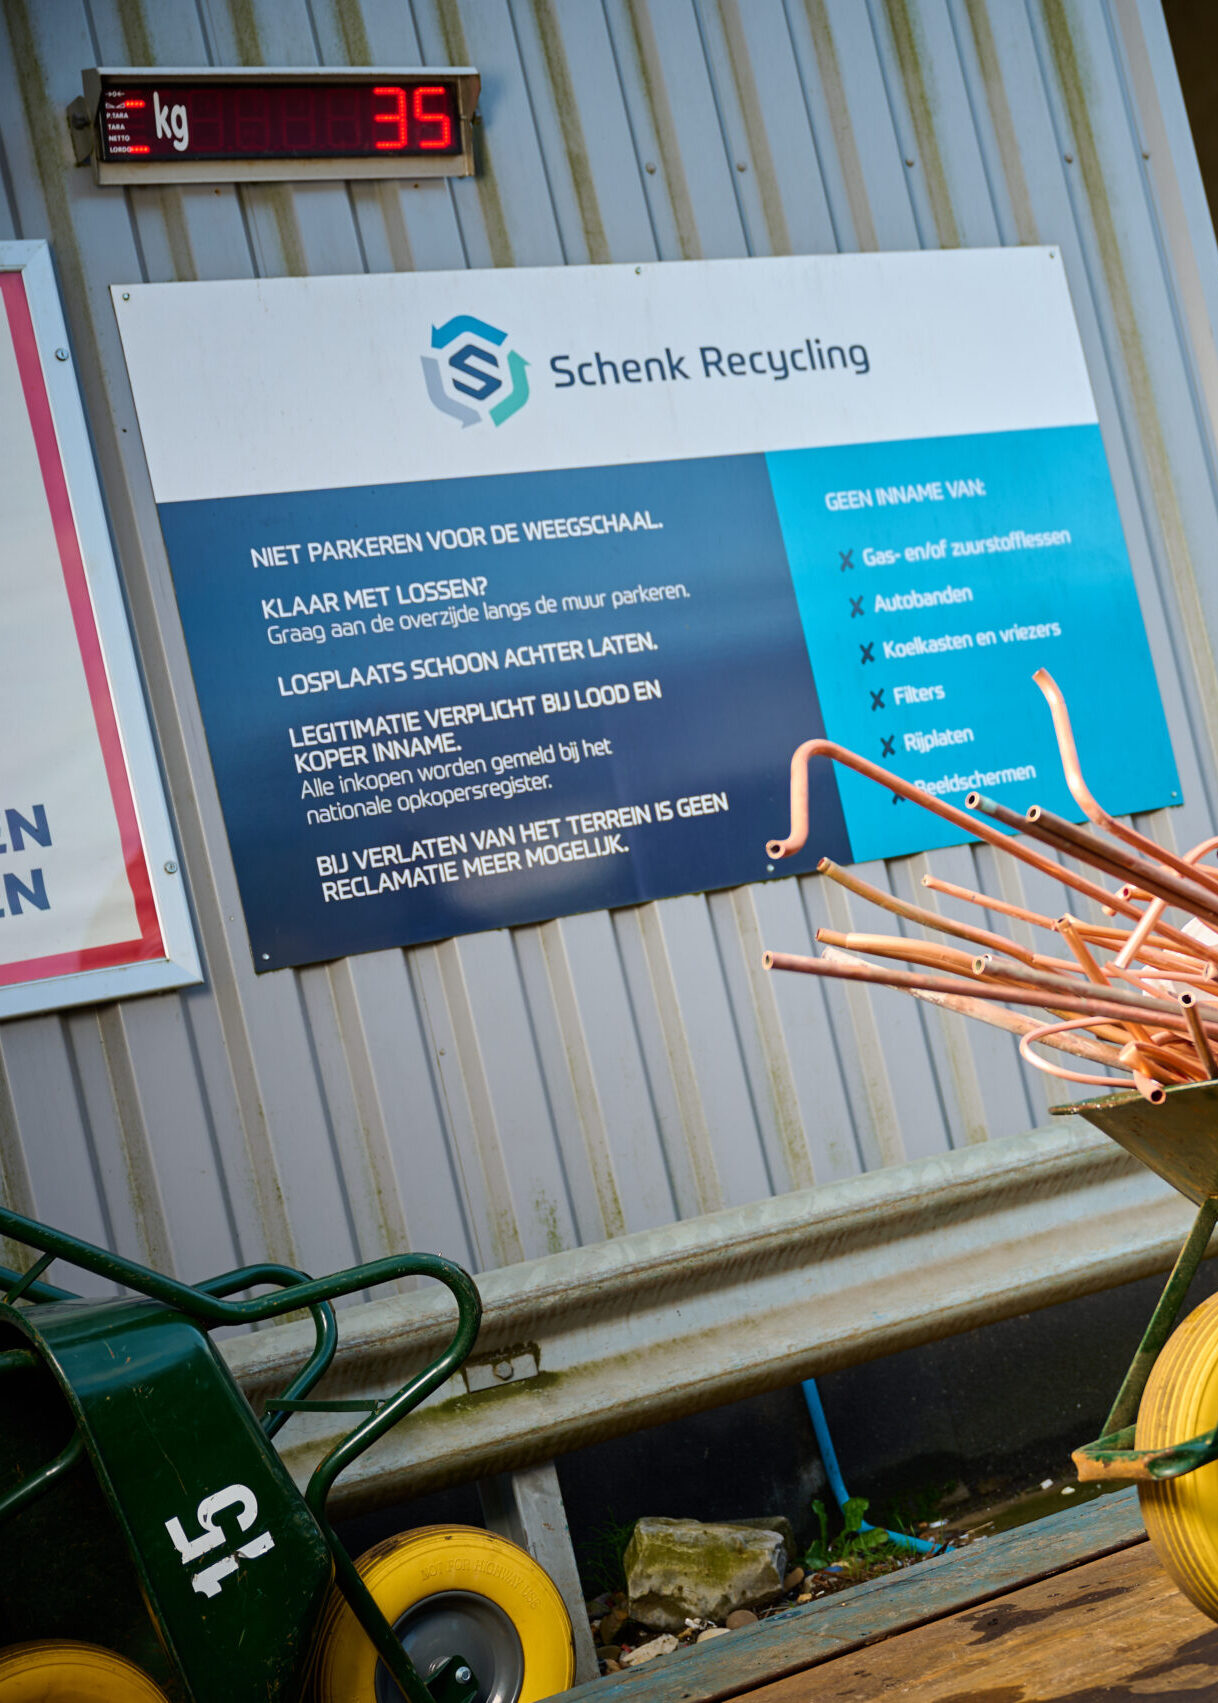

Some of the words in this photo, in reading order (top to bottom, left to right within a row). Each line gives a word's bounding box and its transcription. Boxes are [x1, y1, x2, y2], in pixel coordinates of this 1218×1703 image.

[108, 134, 131, 142] NETTO
[153, 91, 189, 151] kg
[373, 86, 453, 150] 35
[550, 348, 690, 388] Schenk
[699, 339, 870, 381] Recycling
[825, 489, 874, 511] GEEN
[875, 482, 944, 506] INNAME
[945, 478, 986, 499] VAN:
[250, 544, 301, 568] NIET
[307, 532, 423, 562] PARKEREN
[426, 526, 488, 550] VOOR
[490, 523, 520, 544] DE
[522, 510, 663, 541] WEEGSCHAAL.
[862, 547, 901, 567] Gas-
[904, 538, 947, 562] en/of
[950, 529, 1072, 557] zuurstofflessen
[261, 592, 340, 619] KLAAR
[343, 586, 390, 610] MET
[396, 576, 488, 605] LOSSEN?
[267, 625, 326, 645] Graag
[331, 620, 367, 638] aan
[371, 613, 394, 633] de
[399, 604, 479, 630] overzijde
[482, 601, 532, 621] langs
[535, 595, 557, 614] de
[562, 593, 606, 611] muur
[611, 584, 690, 609] parkeren.
[874, 585, 973, 613] Autobanden
[278, 661, 408, 696] LOSPLAATS
[410, 650, 499, 680] SCHOON
[504, 640, 585, 668] ACHTER
[587, 631, 658, 658] LATEN.
[882, 634, 973, 659] Koelkasten
[976, 631, 997, 646] en
[999, 622, 1062, 643] vriezers
[289, 711, 422, 748] LEGITIMATIE
[424, 695, 536, 729] VERPLICHT
[541, 691, 571, 713] BIJ
[574, 684, 630, 709] LOOD
[633, 679, 662, 701] EN
[893, 685, 946, 705] Filters
[294, 745, 369, 773] KOPER
[372, 732, 462, 762] INNAME.
[903, 728, 974, 753] Rijplaten
[301, 777, 334, 800] Alle
[338, 769, 414, 793] inkopen
[417, 757, 487, 782] worden
[491, 744, 556, 775] gemeld
[558, 741, 580, 764] bij
[582, 738, 613, 758] het
[914, 765, 1036, 795] Beeldschermen
[307, 795, 392, 825] nationale
[397, 774, 552, 813] opkopersregister.
[316, 853, 349, 876] BIJ
[352, 833, 468, 870] VERLATEN
[470, 826, 516, 851] VAN
[519, 818, 561, 843] HET
[565, 804, 652, 835] TERREIN
[654, 800, 674, 822] IS
[676, 792, 729, 818] GEEN
[322, 860, 460, 902] RECLAMATIE
[462, 851, 522, 879] MEER
[525, 834, 629, 868] MOGELIJK.
[164, 1484, 275, 1599] 15
